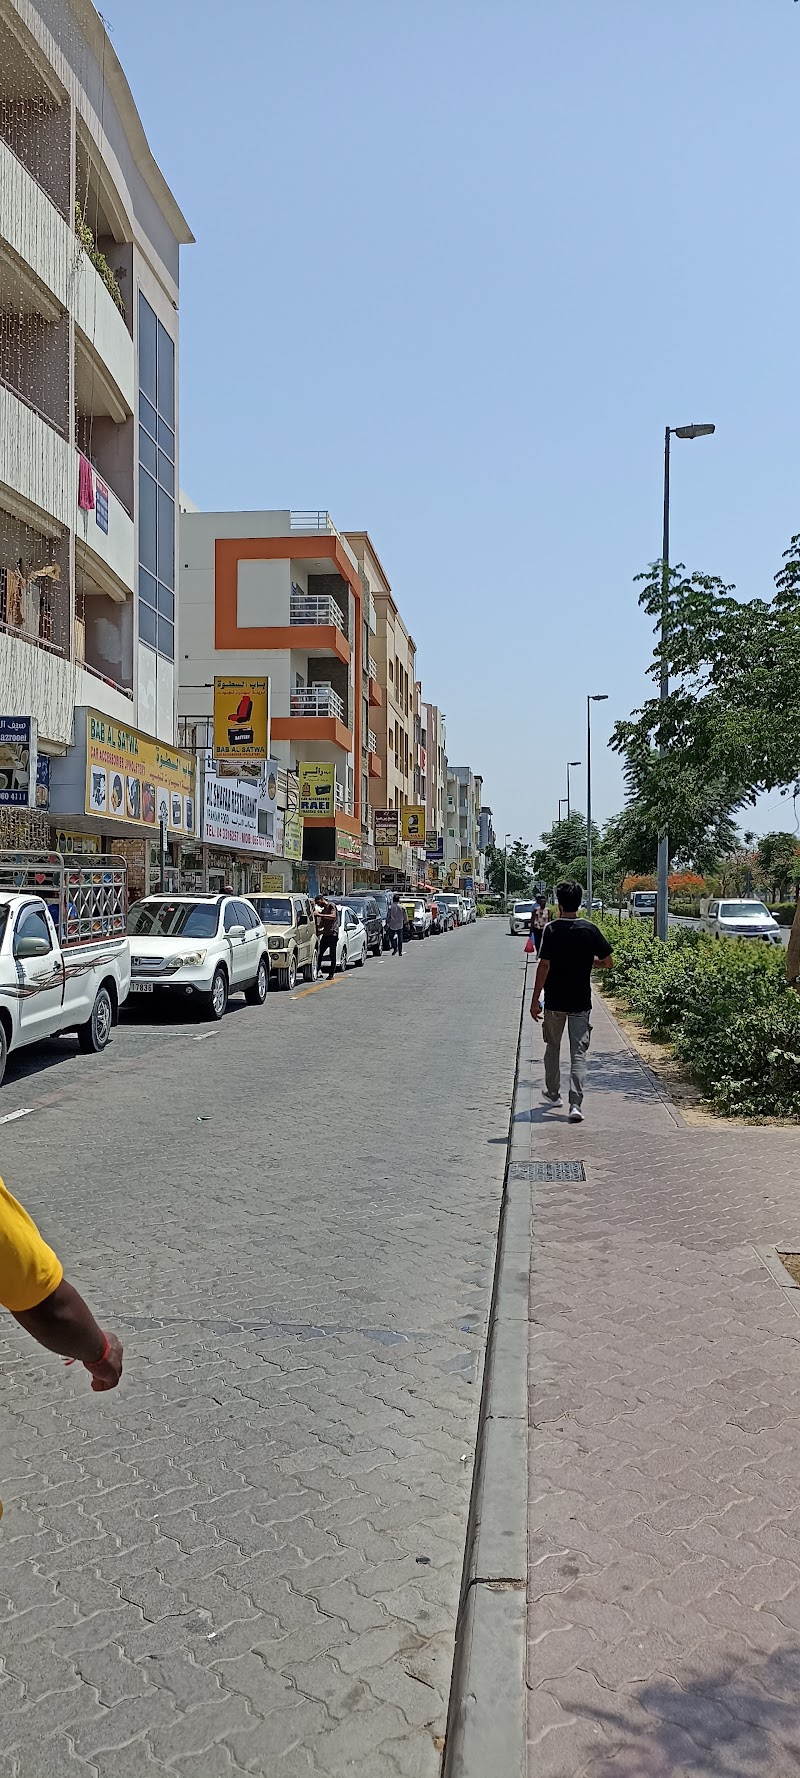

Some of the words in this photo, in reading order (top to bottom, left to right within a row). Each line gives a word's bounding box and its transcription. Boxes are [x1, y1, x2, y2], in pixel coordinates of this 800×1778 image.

[91, 717, 105, 743] BAB
[107, 725, 116, 748] AL
[117, 729, 139, 757] SATWA
[10, 792, 26, 801] 4111
[301, 801, 330, 810] RAEI
